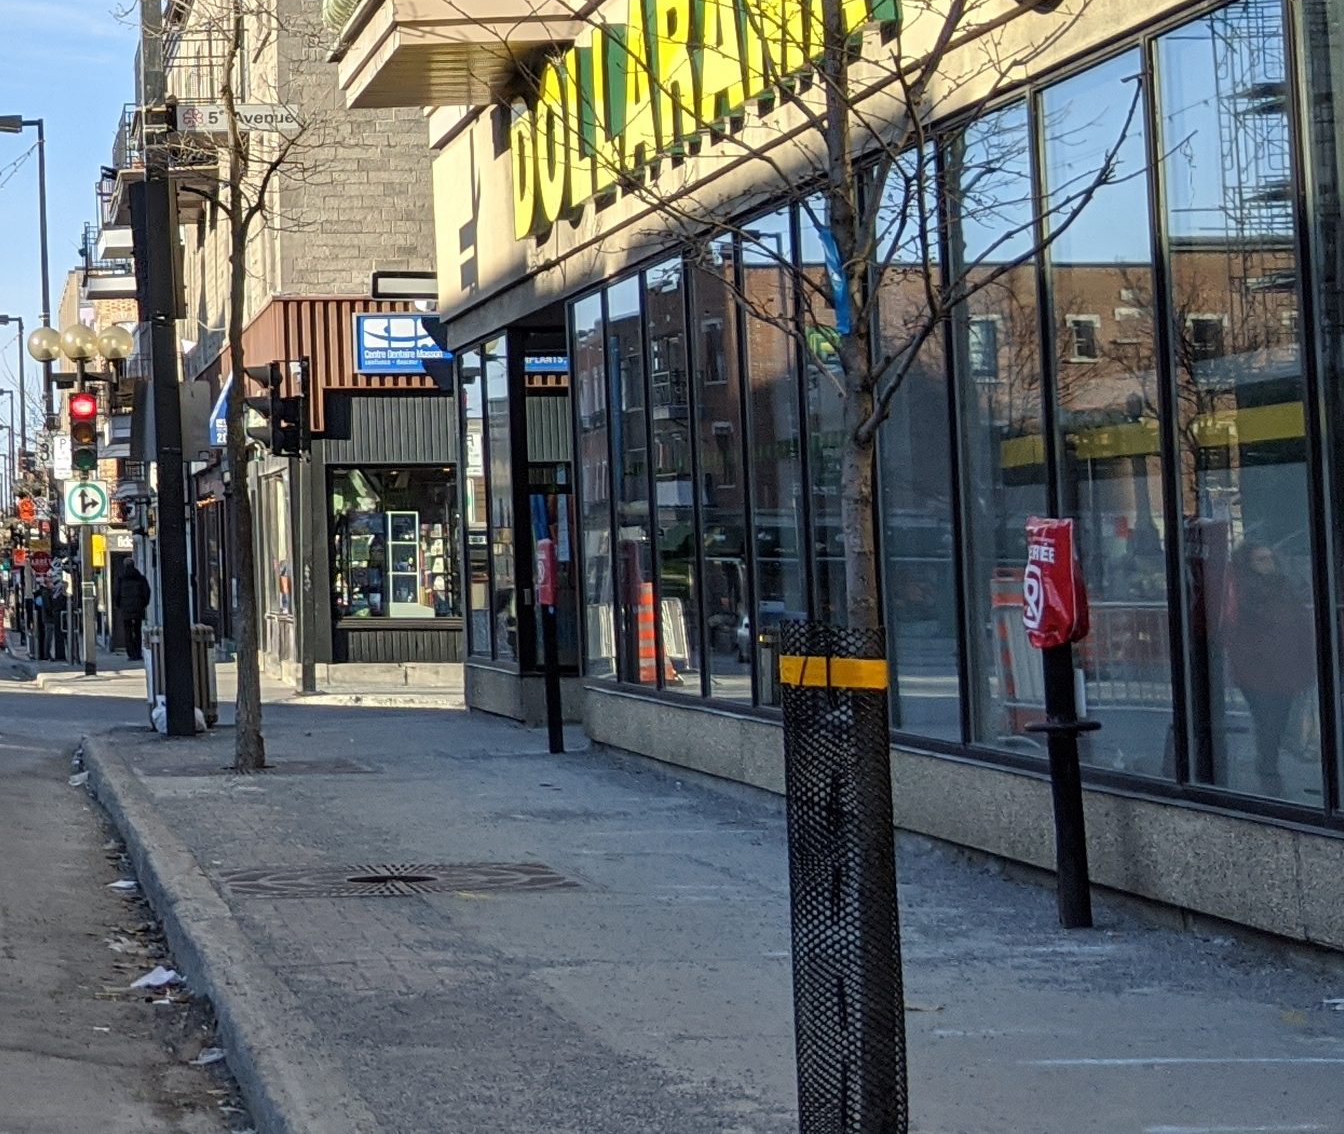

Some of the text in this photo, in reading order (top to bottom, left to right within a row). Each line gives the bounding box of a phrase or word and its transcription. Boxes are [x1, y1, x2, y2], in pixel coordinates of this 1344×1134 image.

[233, 109, 295, 126] Avenue
[364, 349, 387, 359] Centre
[387, 348, 416, 359] Dentaire
